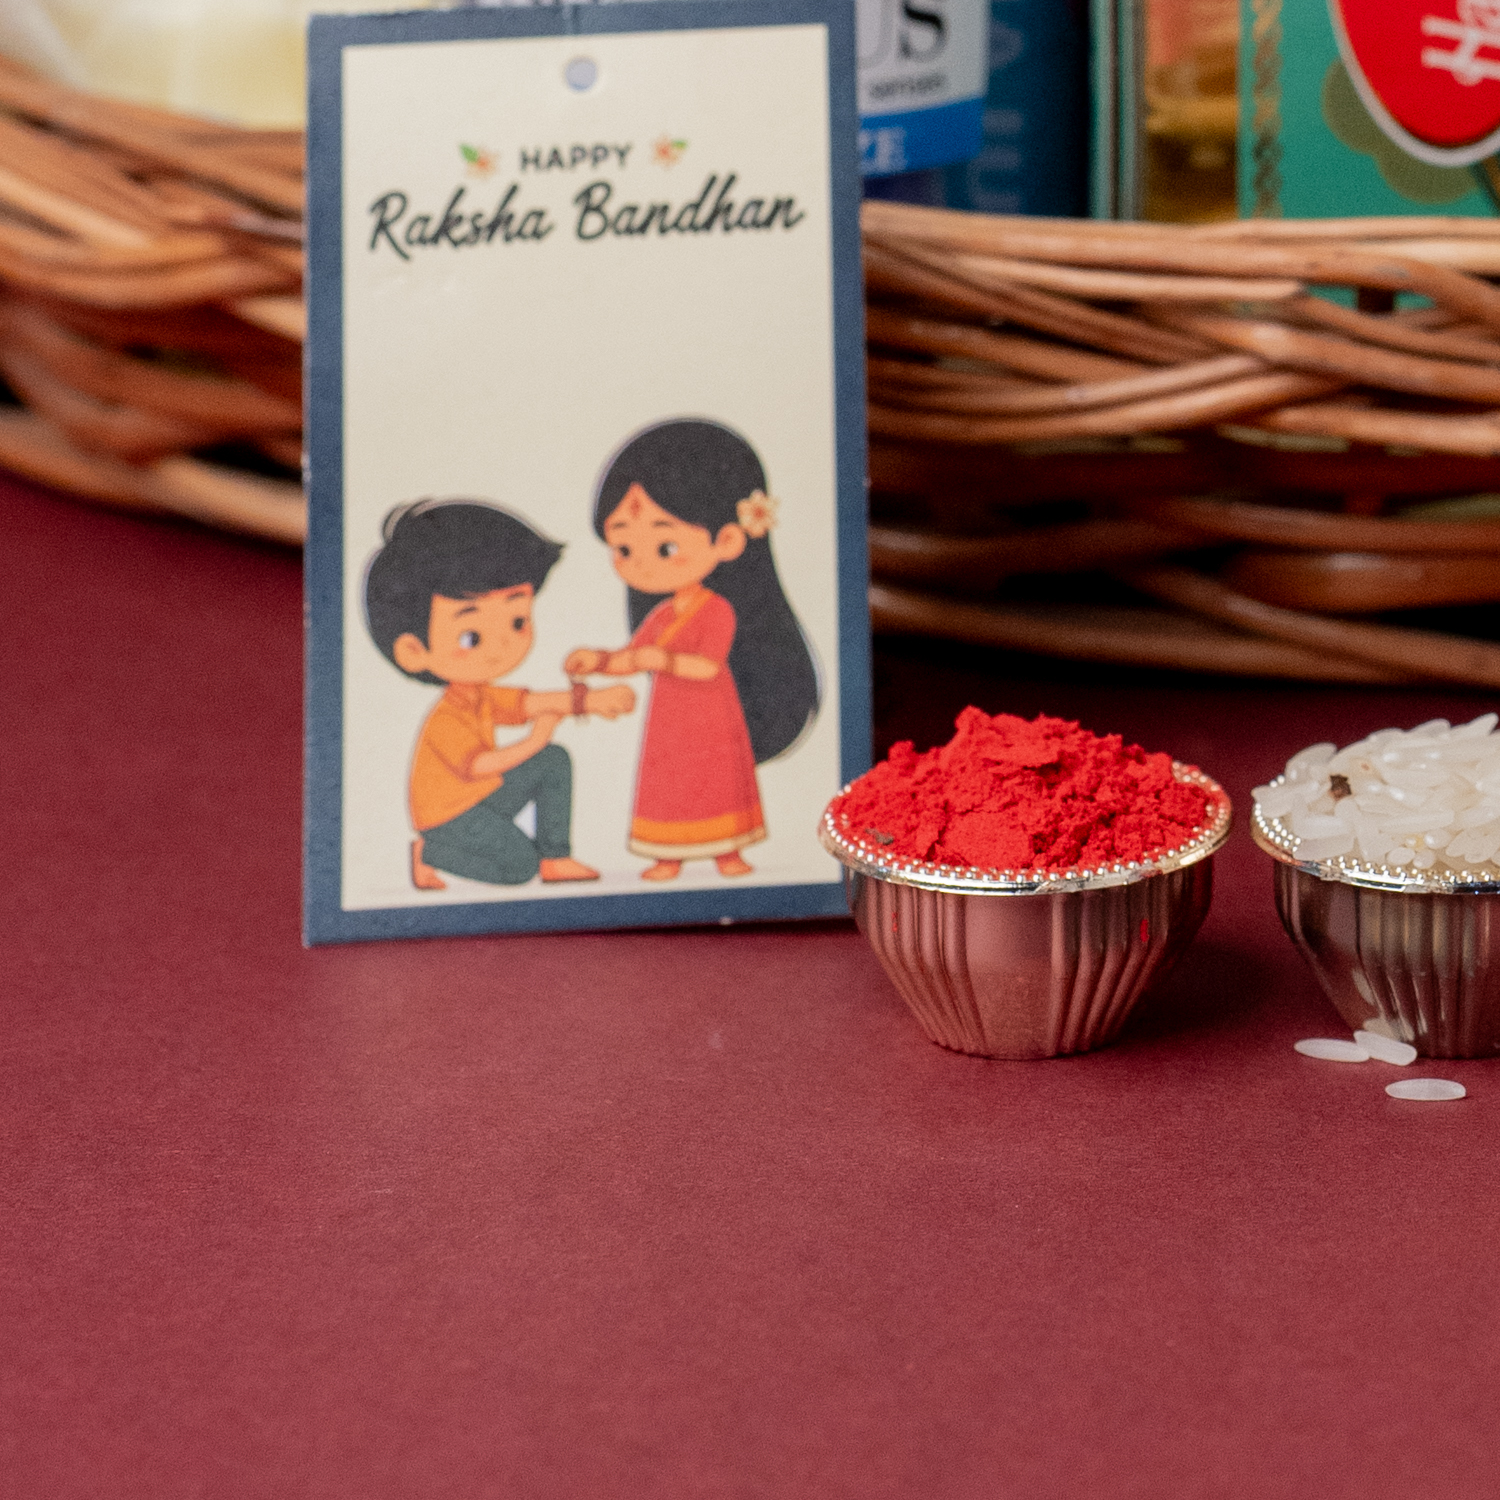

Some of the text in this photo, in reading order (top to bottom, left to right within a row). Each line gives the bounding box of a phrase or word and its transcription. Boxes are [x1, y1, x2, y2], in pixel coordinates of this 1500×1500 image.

[519, 142, 635, 173] HAPPY
[368, 170, 808, 262] Raksha Bandhan
